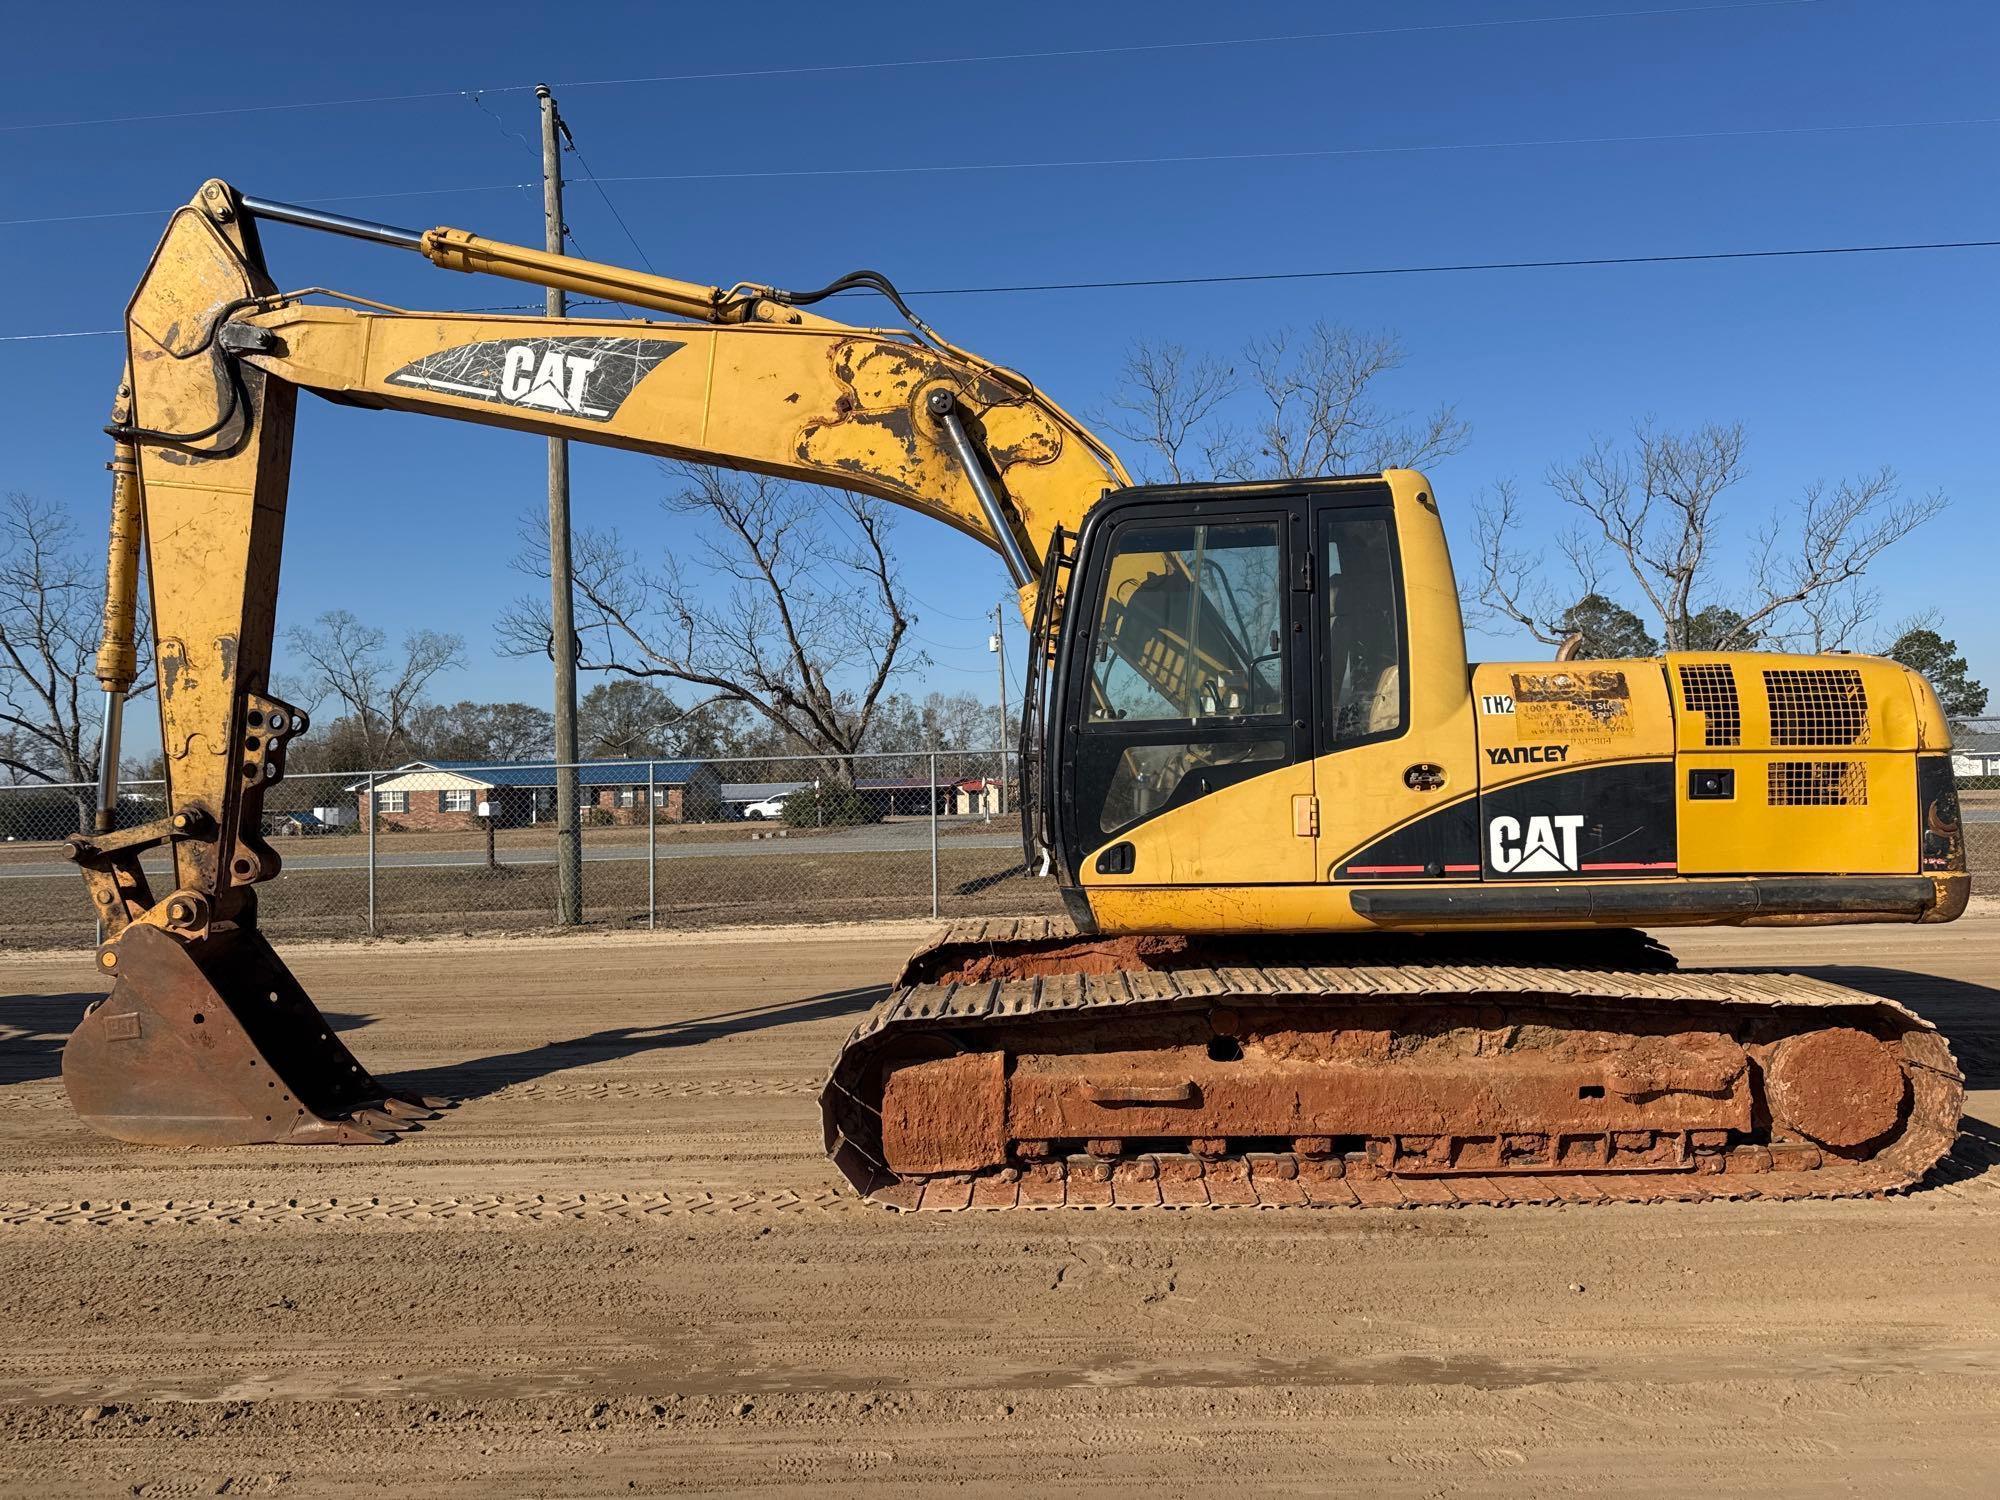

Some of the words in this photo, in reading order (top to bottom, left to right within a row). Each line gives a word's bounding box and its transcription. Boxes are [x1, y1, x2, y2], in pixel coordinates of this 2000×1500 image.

[500, 346, 596, 414] CAT
[1483, 696, 1514, 714] TH2
[1485, 745, 1570, 765] YANCEY
[1489, 815, 1584, 873] CAT
